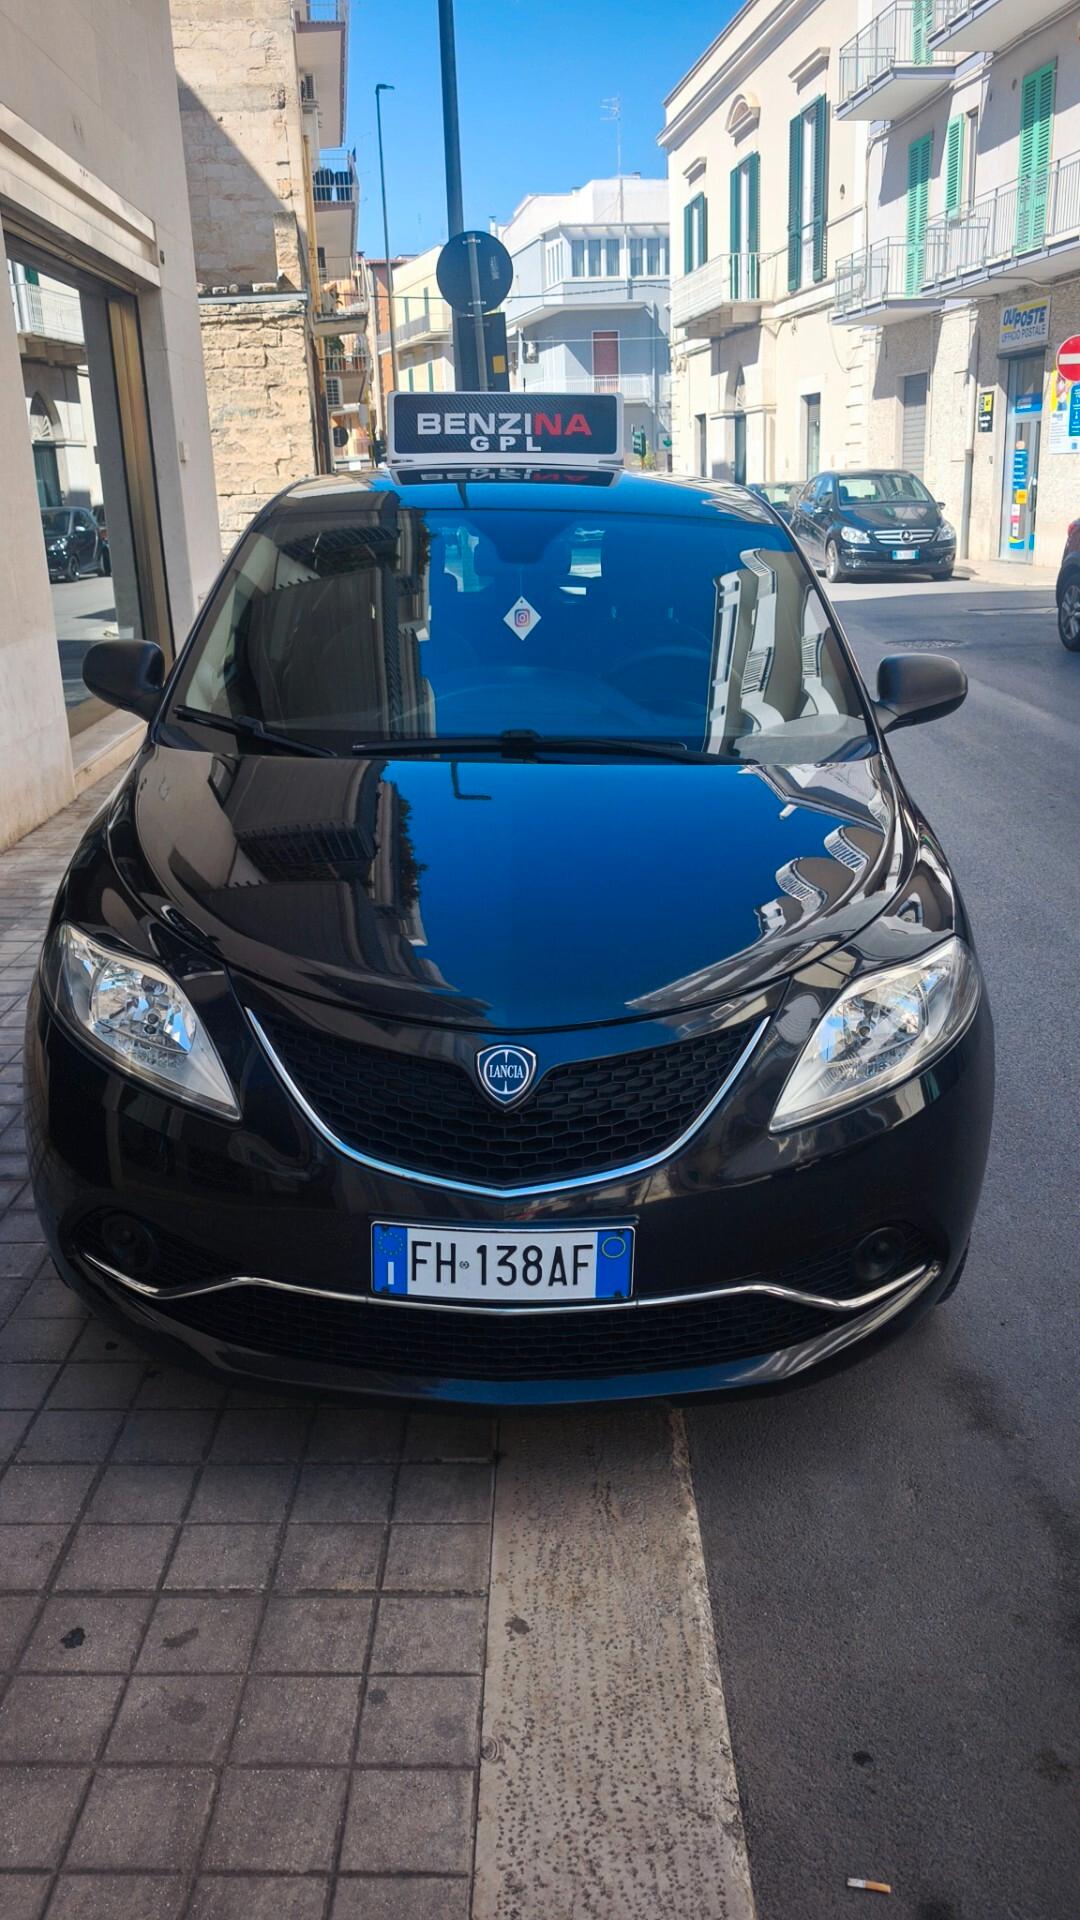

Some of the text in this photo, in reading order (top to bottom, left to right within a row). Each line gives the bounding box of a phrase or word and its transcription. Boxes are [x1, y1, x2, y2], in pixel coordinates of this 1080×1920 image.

[1022, 323, 1046, 338] POSTALE
[417, 412, 592, 436] BENZINA
[470, 436, 542, 451] GPL
[489, 1064, 524, 1079] LANCIA
